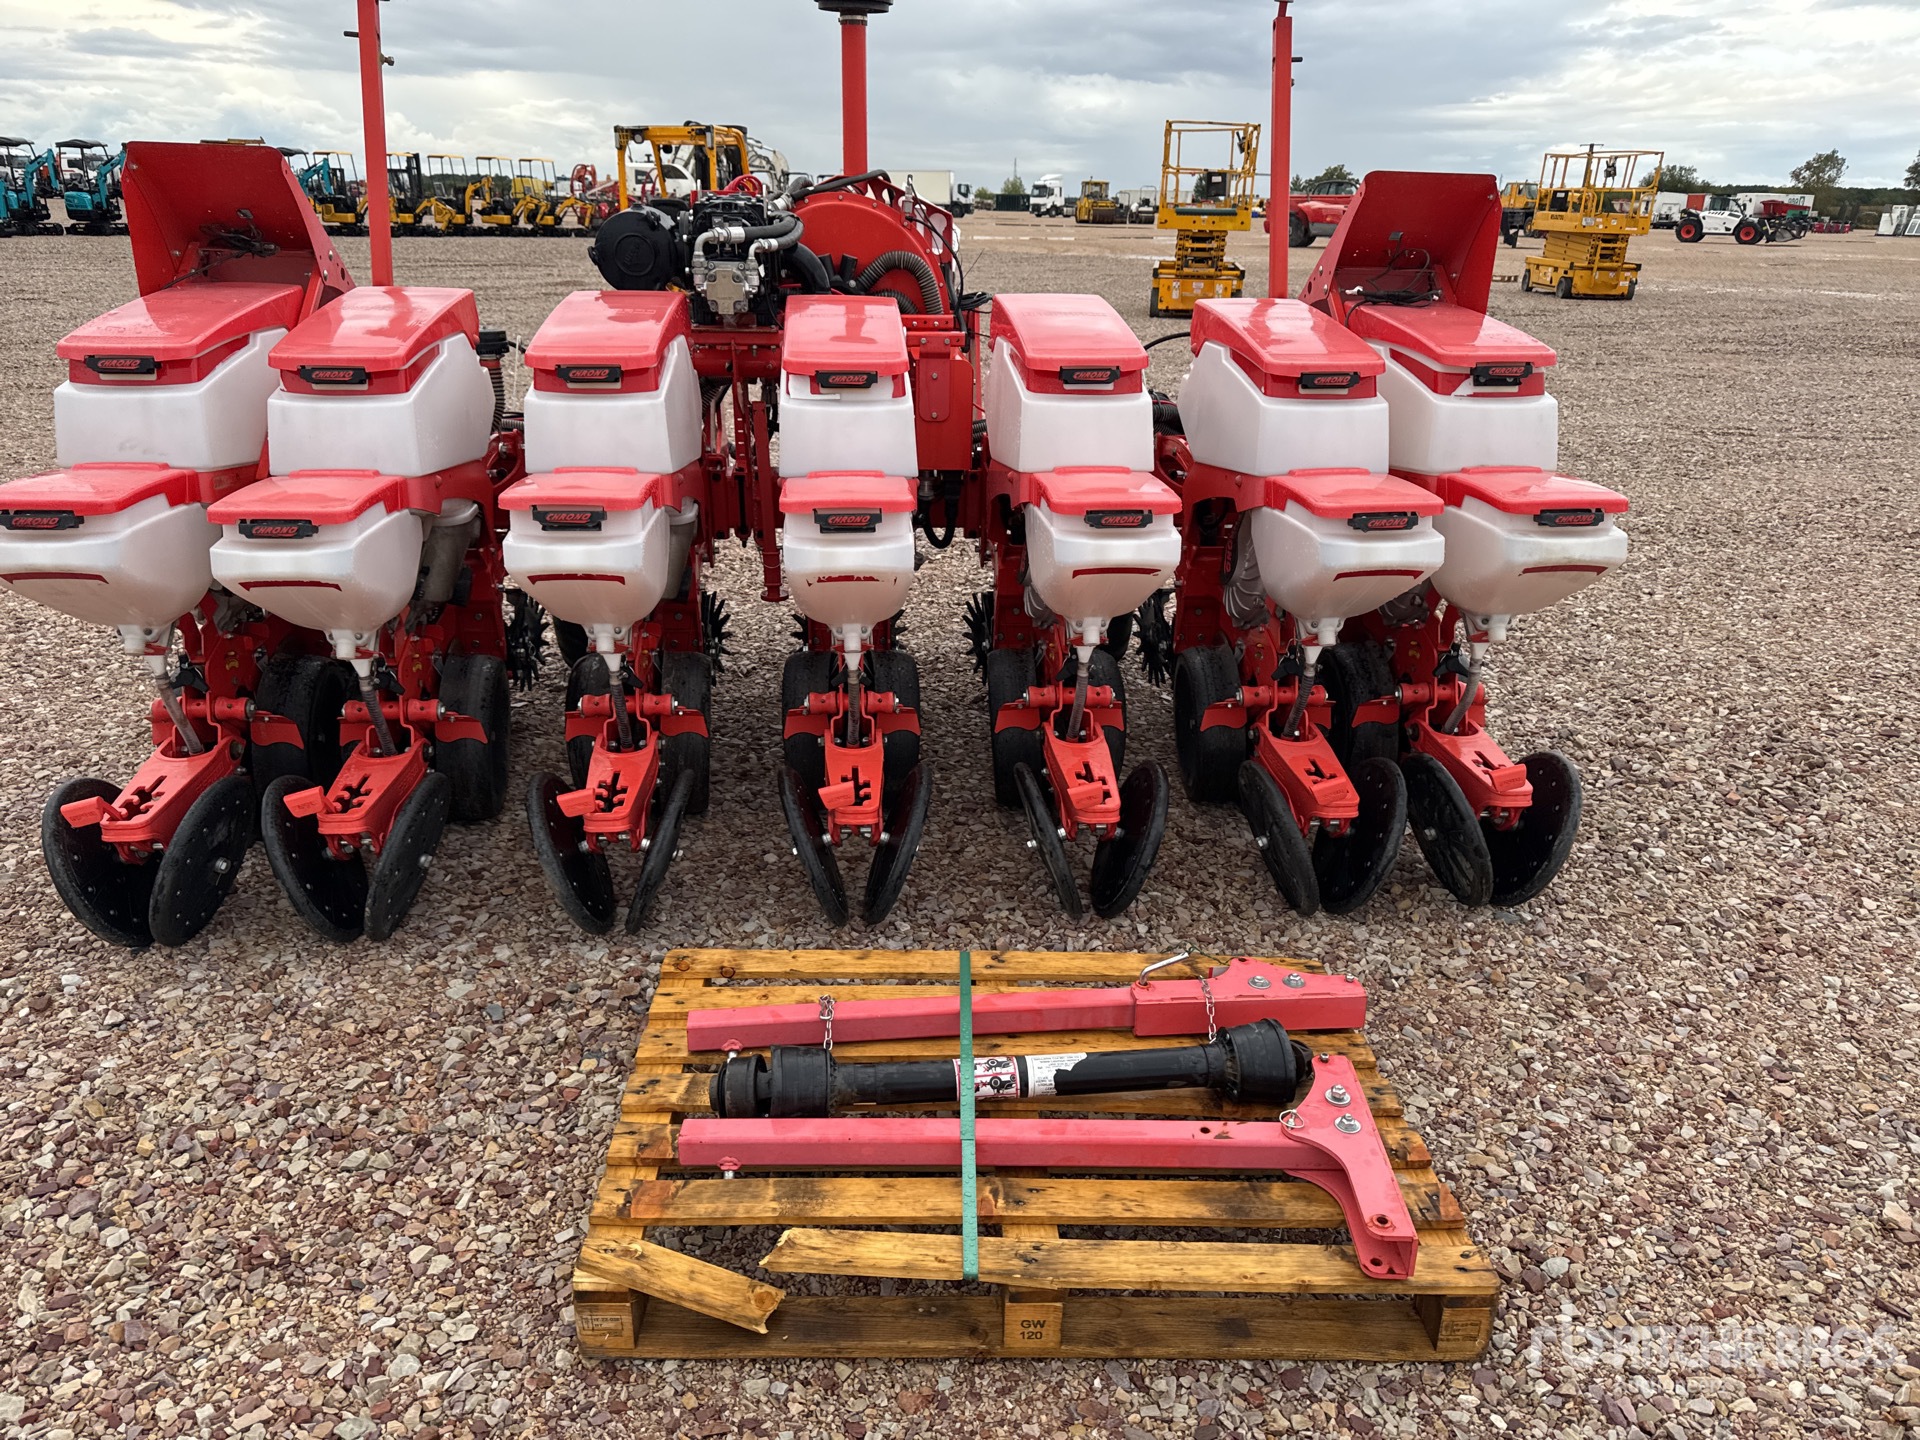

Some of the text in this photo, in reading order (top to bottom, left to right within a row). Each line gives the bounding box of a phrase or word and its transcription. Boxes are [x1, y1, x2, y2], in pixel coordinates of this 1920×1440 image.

[97, 359, 141, 368] CHRONO
[311, 370, 353, 379] CHRONO
[568, 369, 609, 378] CHRONO
[1073, 370, 1111, 380] CHRONO
[1488, 366, 1525, 375] CHRONO
[828, 374, 868, 384] CHRONO
[1313, 376, 1351, 385] CHRONO
[545, 512, 590, 522] CHRONO
[827, 515, 871, 525] CHRONO
[1100, 515, 1143, 525] CHRONO
[1554, 513, 1595, 523] CHRONO
[11, 517, 60, 528] CHRONO
[1367, 517, 1408, 528] CHRONO
[251, 525, 298, 536] CHRONO
[1020, 1320, 1046, 1329] GW
[1019, 1331, 1043, 1340] 120
